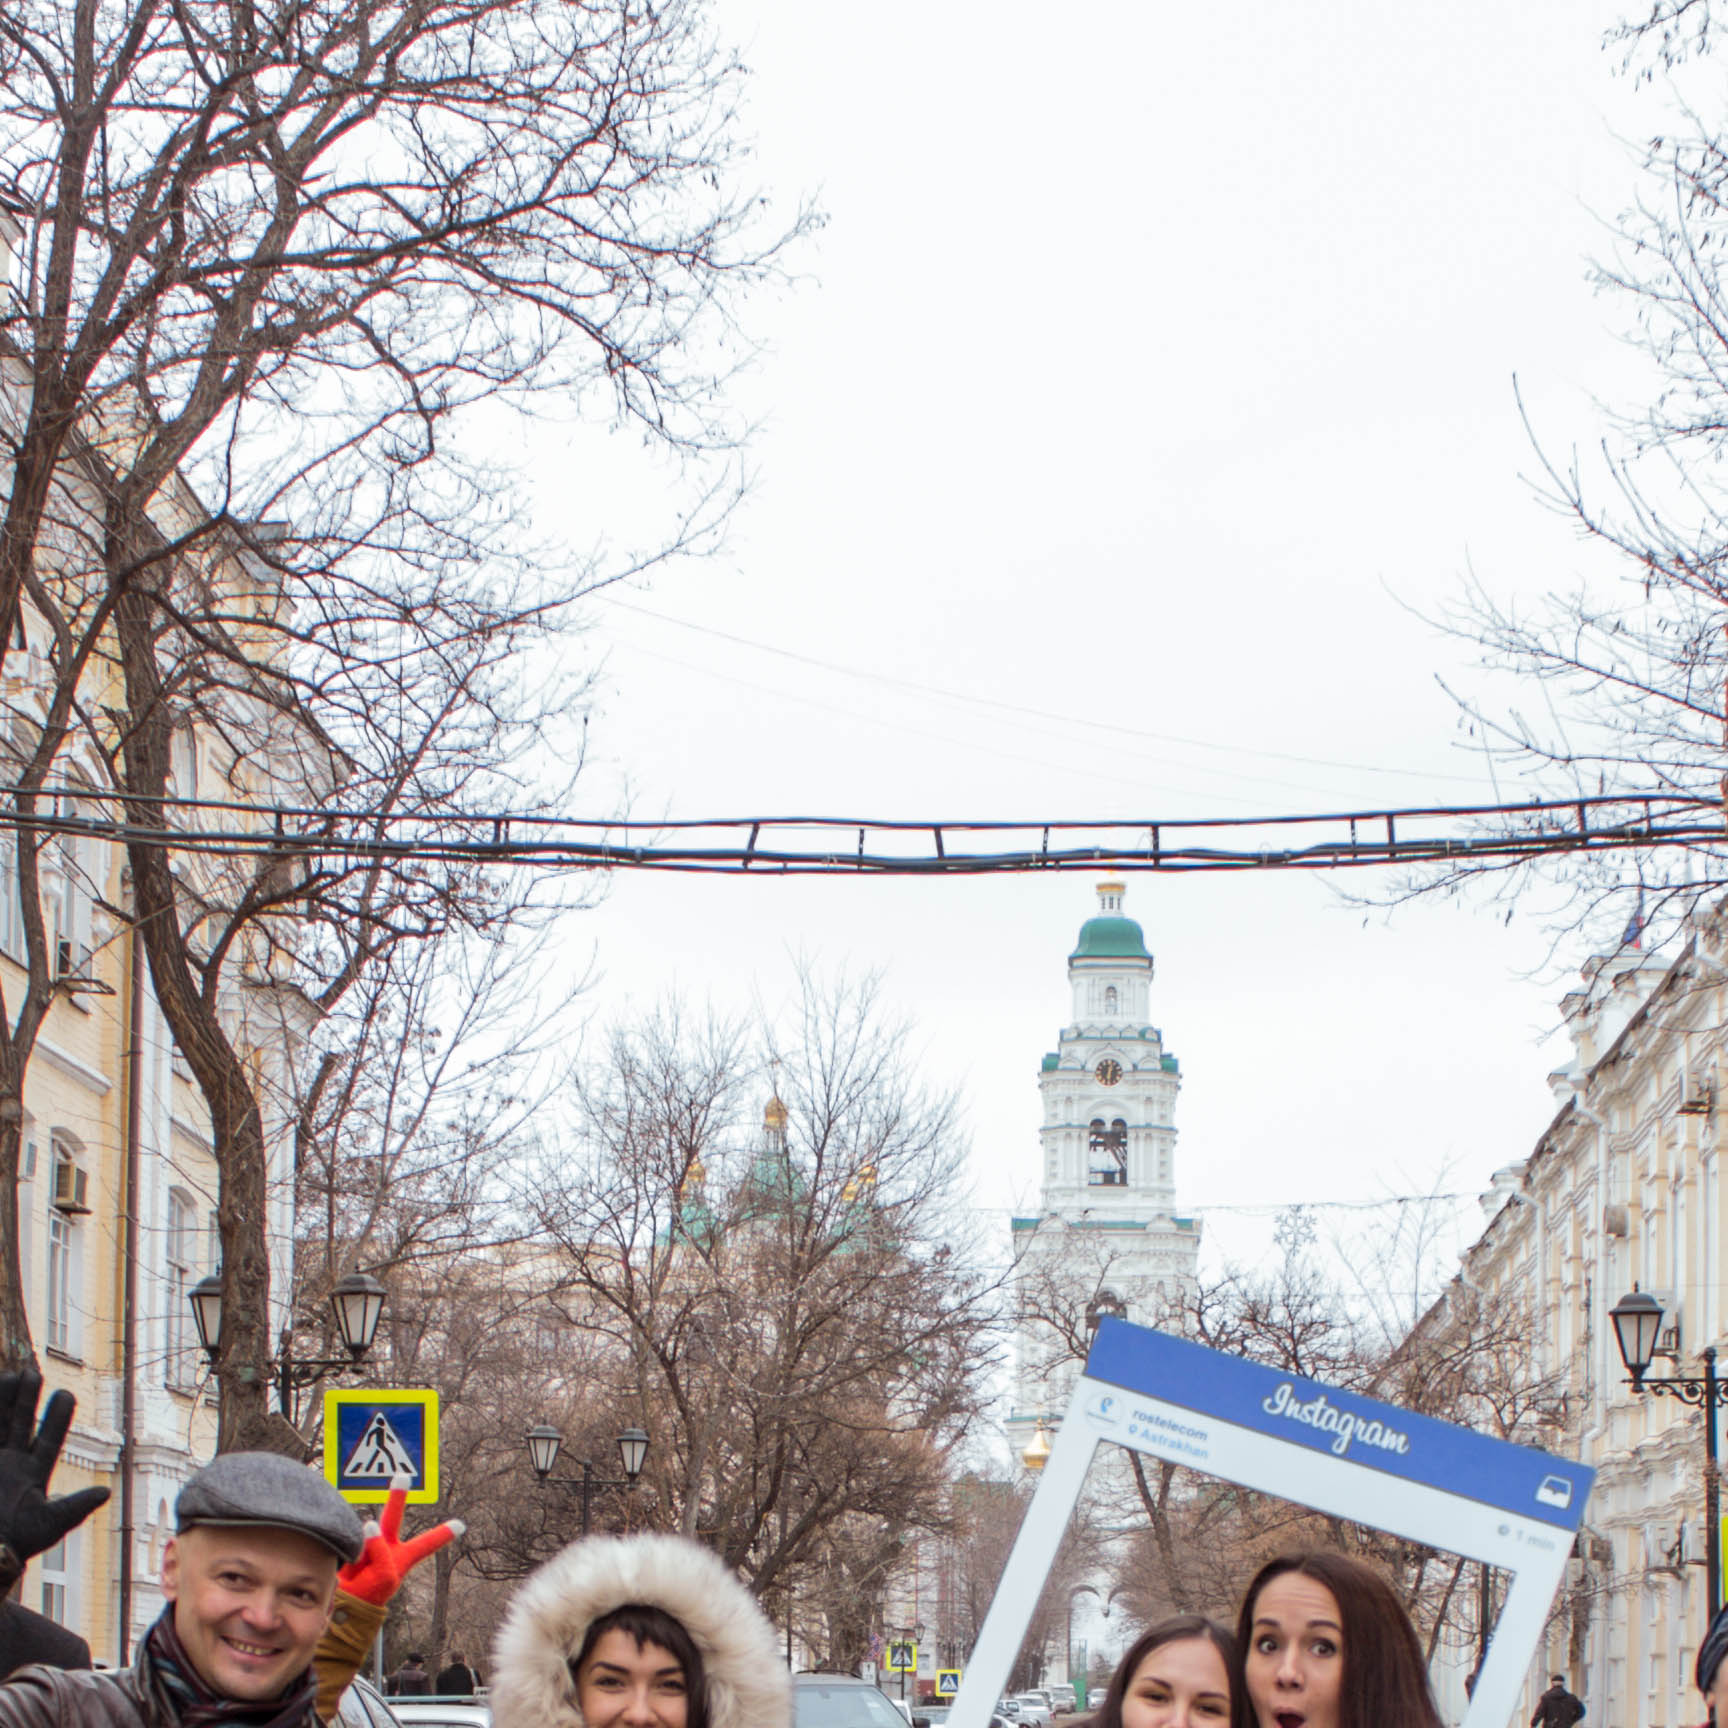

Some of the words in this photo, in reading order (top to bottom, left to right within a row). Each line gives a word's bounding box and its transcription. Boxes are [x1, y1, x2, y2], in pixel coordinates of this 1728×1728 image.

[1133, 1409, 1208, 1441] rostelecom
[1262, 1382, 1410, 1456] Instagram
[1140, 1428, 1209, 1458] Astrakhan
